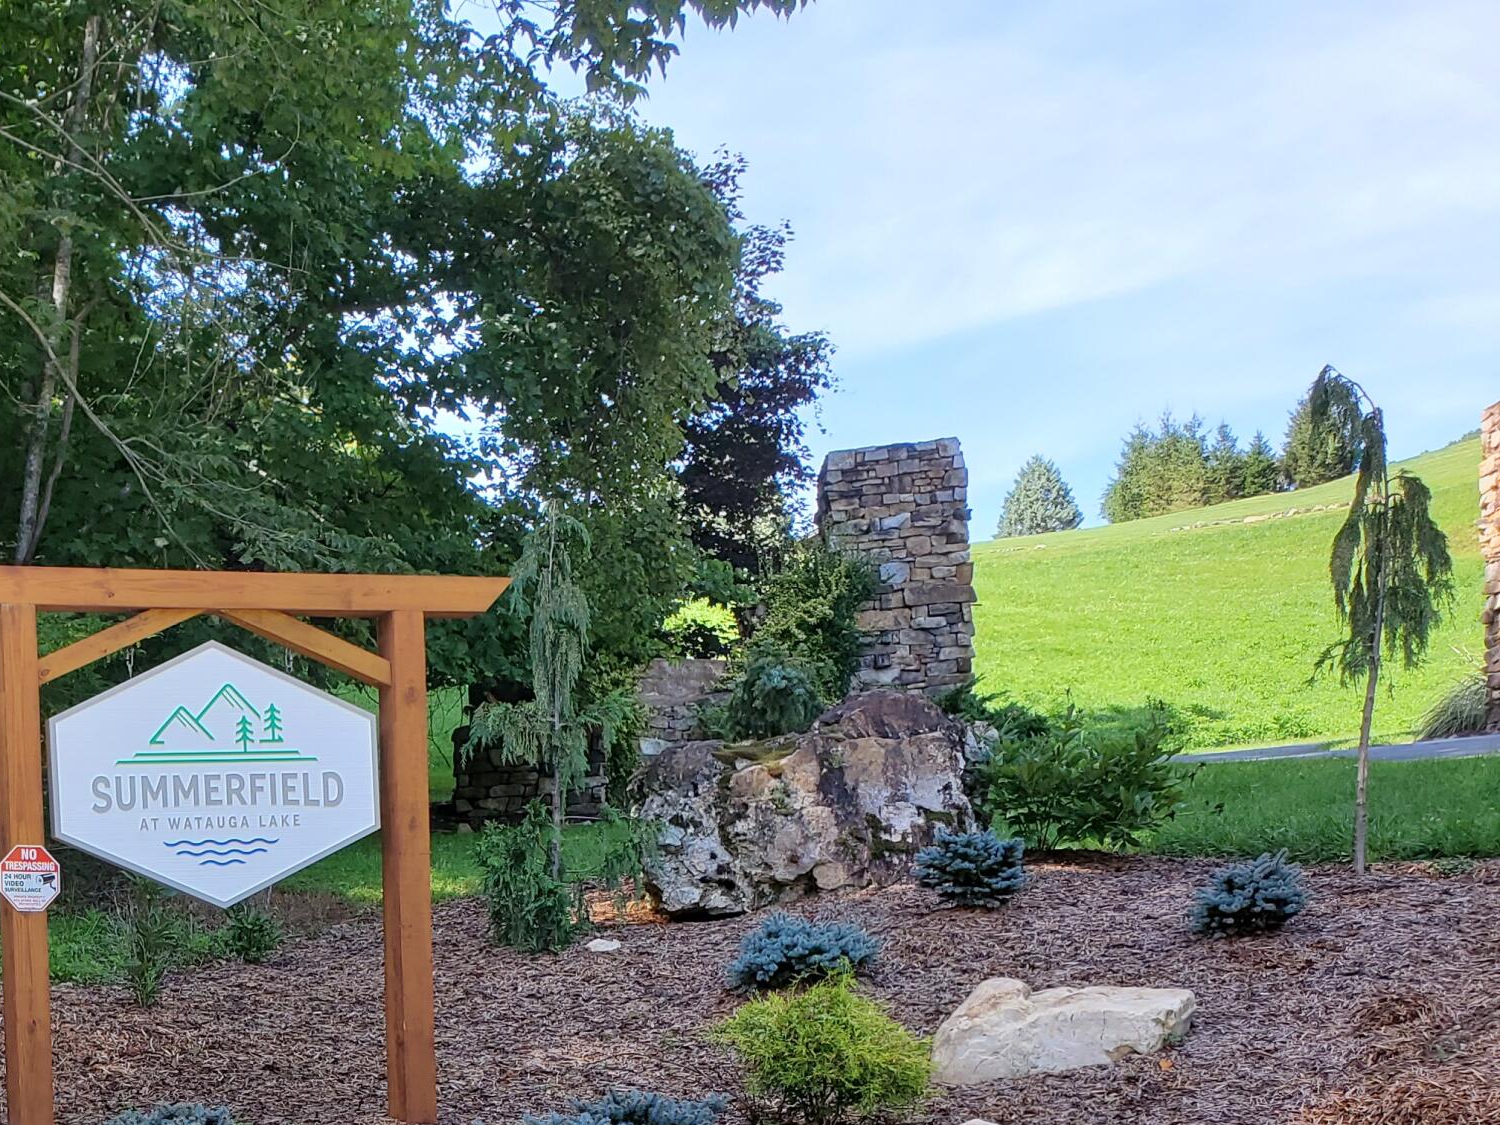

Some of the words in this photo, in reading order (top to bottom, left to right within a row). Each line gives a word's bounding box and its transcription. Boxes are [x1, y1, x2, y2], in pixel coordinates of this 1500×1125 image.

[91, 771, 344, 813] SUMMERFIELD
[140, 817, 160, 831] AT
[168, 815, 250, 830] WATAUGA
[259, 813, 301, 828] LAKE
[21, 848, 37, 860] NO
[4, 861, 55, 871] TRESPASSING
